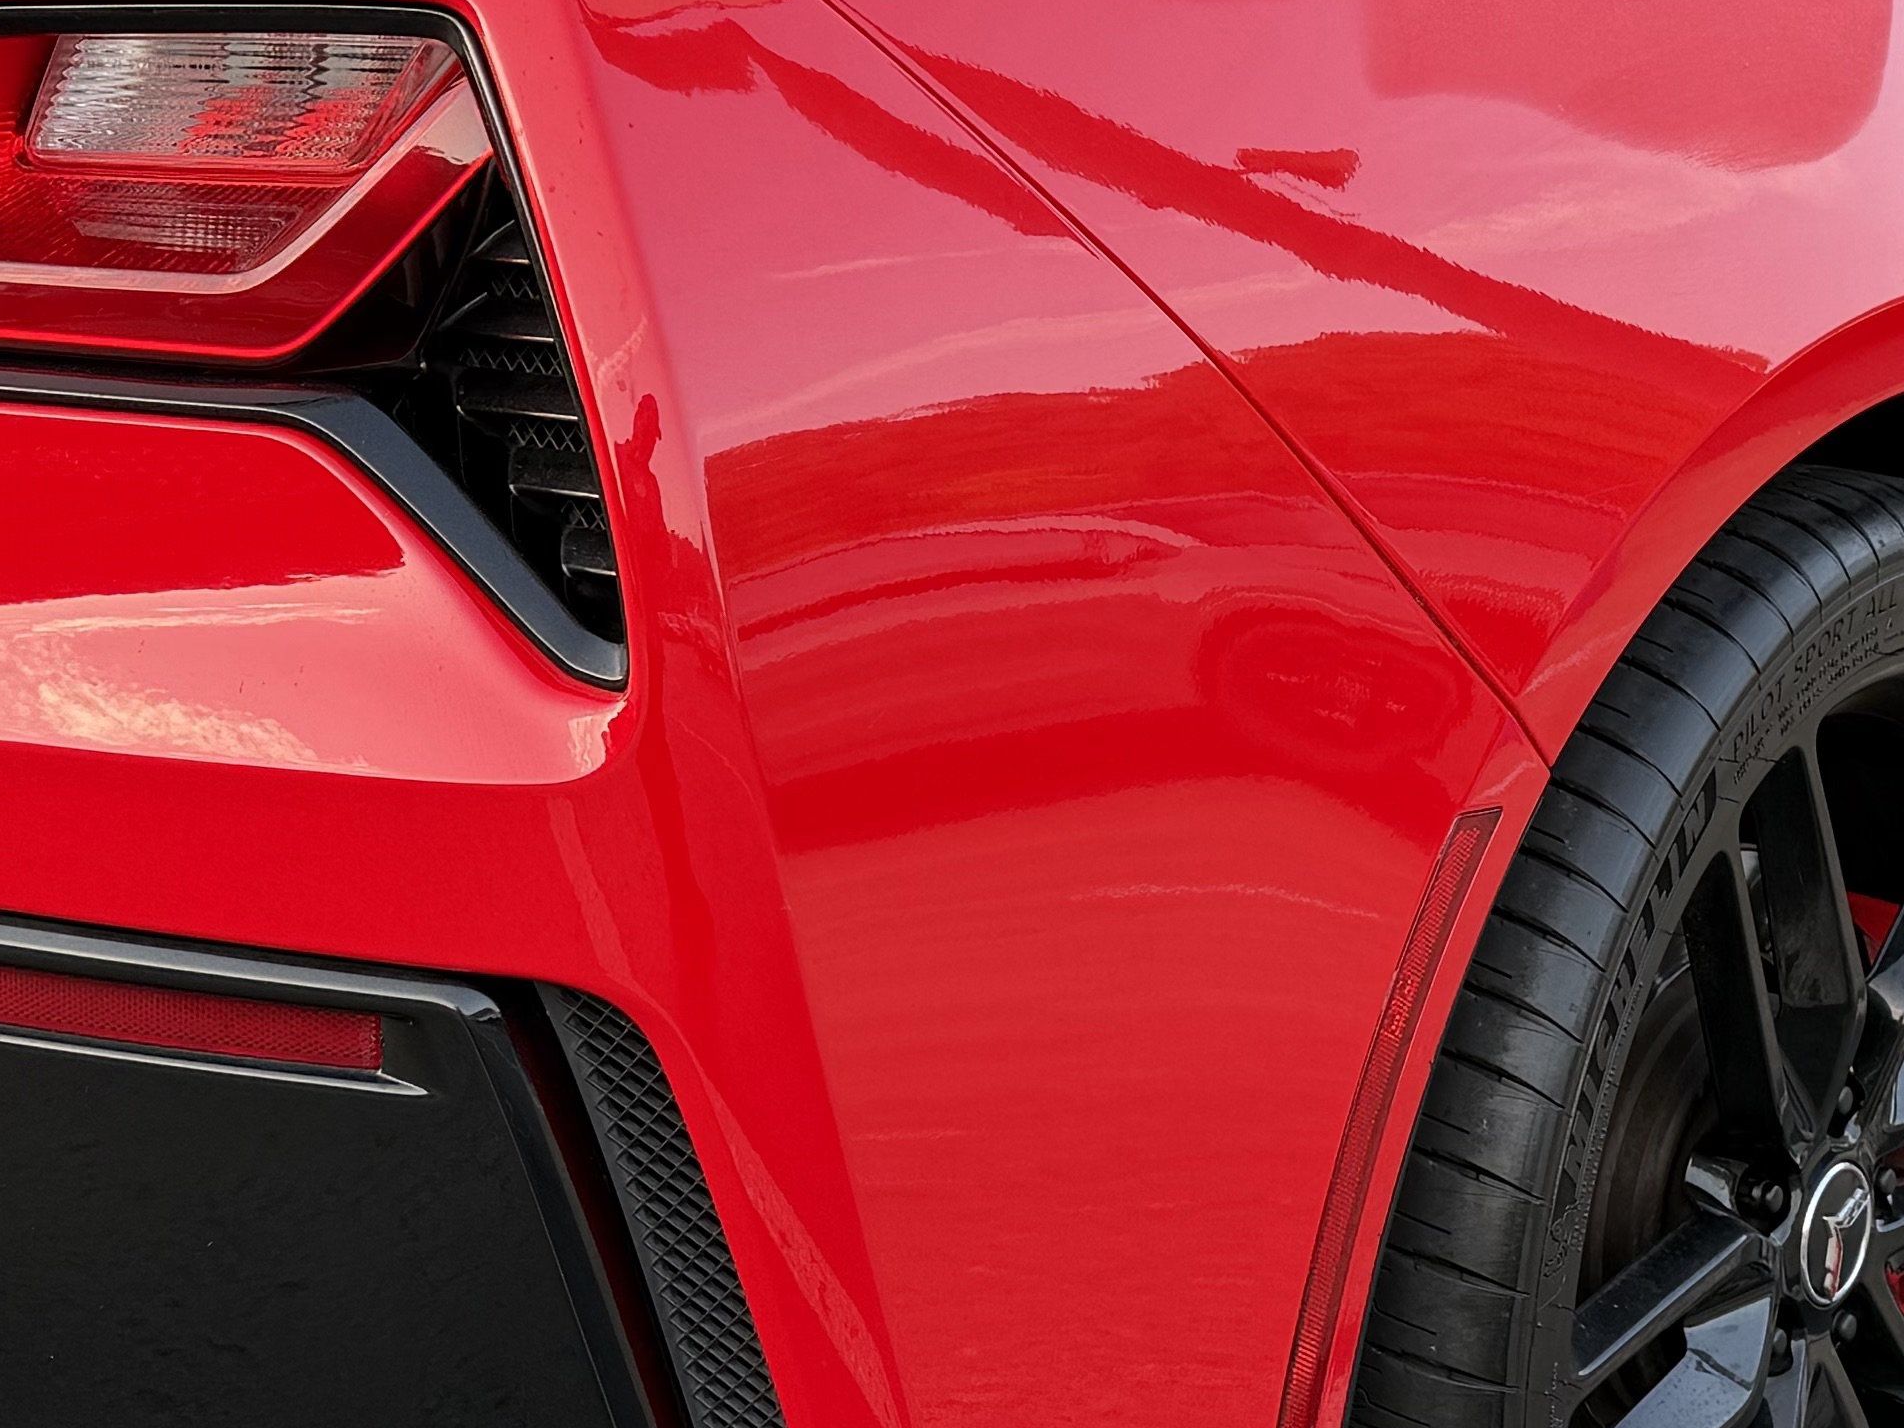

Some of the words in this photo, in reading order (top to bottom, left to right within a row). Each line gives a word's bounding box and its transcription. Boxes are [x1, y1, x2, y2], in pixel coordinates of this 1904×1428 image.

[1731, 673, 1786, 763] PILOT
[1793, 608, 1857, 683] SPORT
[1864, 590, 1897, 622] ALL
[1562, 767, 1717, 1206] MICHELIN
